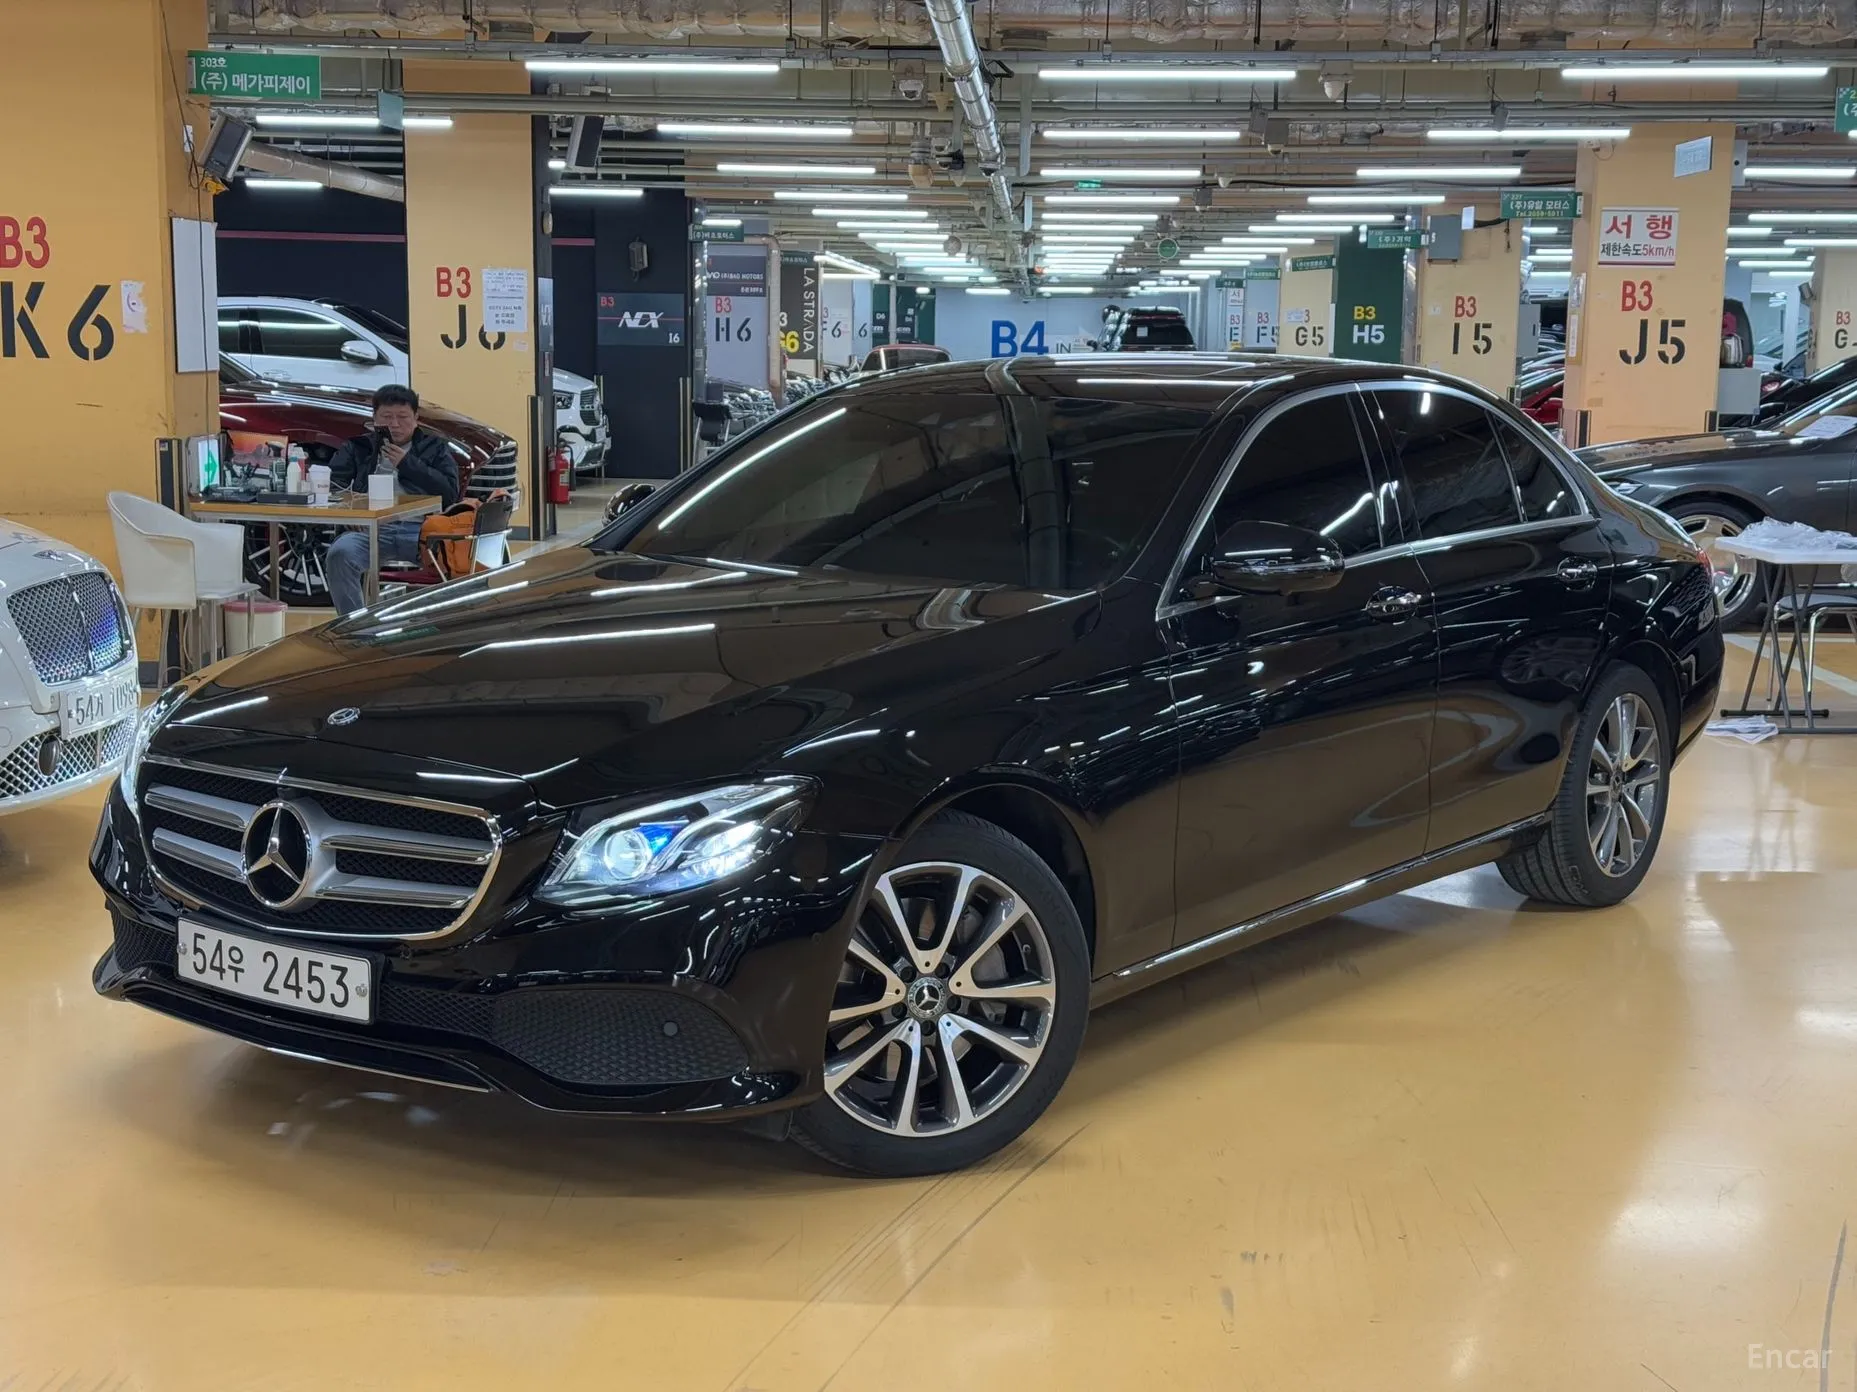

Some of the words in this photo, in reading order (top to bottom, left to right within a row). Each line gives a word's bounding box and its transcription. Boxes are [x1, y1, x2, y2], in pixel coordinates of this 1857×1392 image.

[200, 57, 227, 68] 303호
[232, 73, 310, 95] 메가피제이
[0, 216, 50, 269] B3
[436, 266, 472, 299] B3
[804, 267, 815, 287] LA
[600, 296, 615, 308] B3
[715, 297, 732, 313] B3
[1621, 280, 1653, 312] B3
[1354, 305, 1376, 320] B3
[1454, 295, 1477, 318] B3
[804, 291, 815, 353] STRADA
[1230, 314, 1240, 325] B3
[1257, 312, 1270, 324] B3
[1835, 310, 1851, 325] B3
[991, 320, 1049, 358] B4
[1056, 342, 1072, 354] IN
[1229, 327, 1240, 342] E
[1352, 324, 1385, 345] H5
[193, 932, 245, 983] 54우
[262, 951, 349, 1008] 2453
